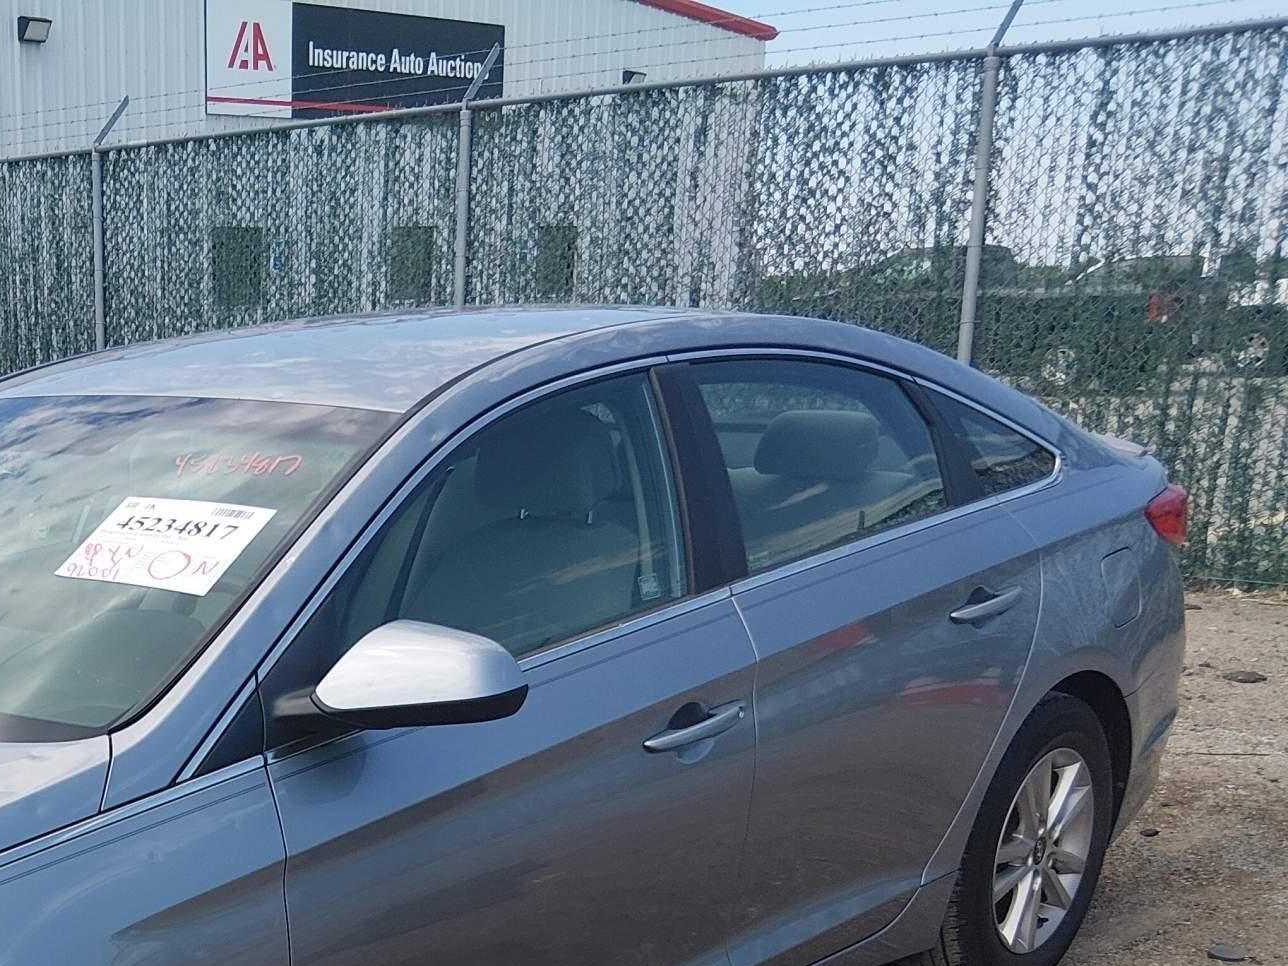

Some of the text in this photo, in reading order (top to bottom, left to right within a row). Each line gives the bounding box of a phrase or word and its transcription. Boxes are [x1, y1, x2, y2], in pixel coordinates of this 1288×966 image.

[308, 40, 490, 81] Insurance Auto Auction
[116, 515, 240, 541] 45234817
